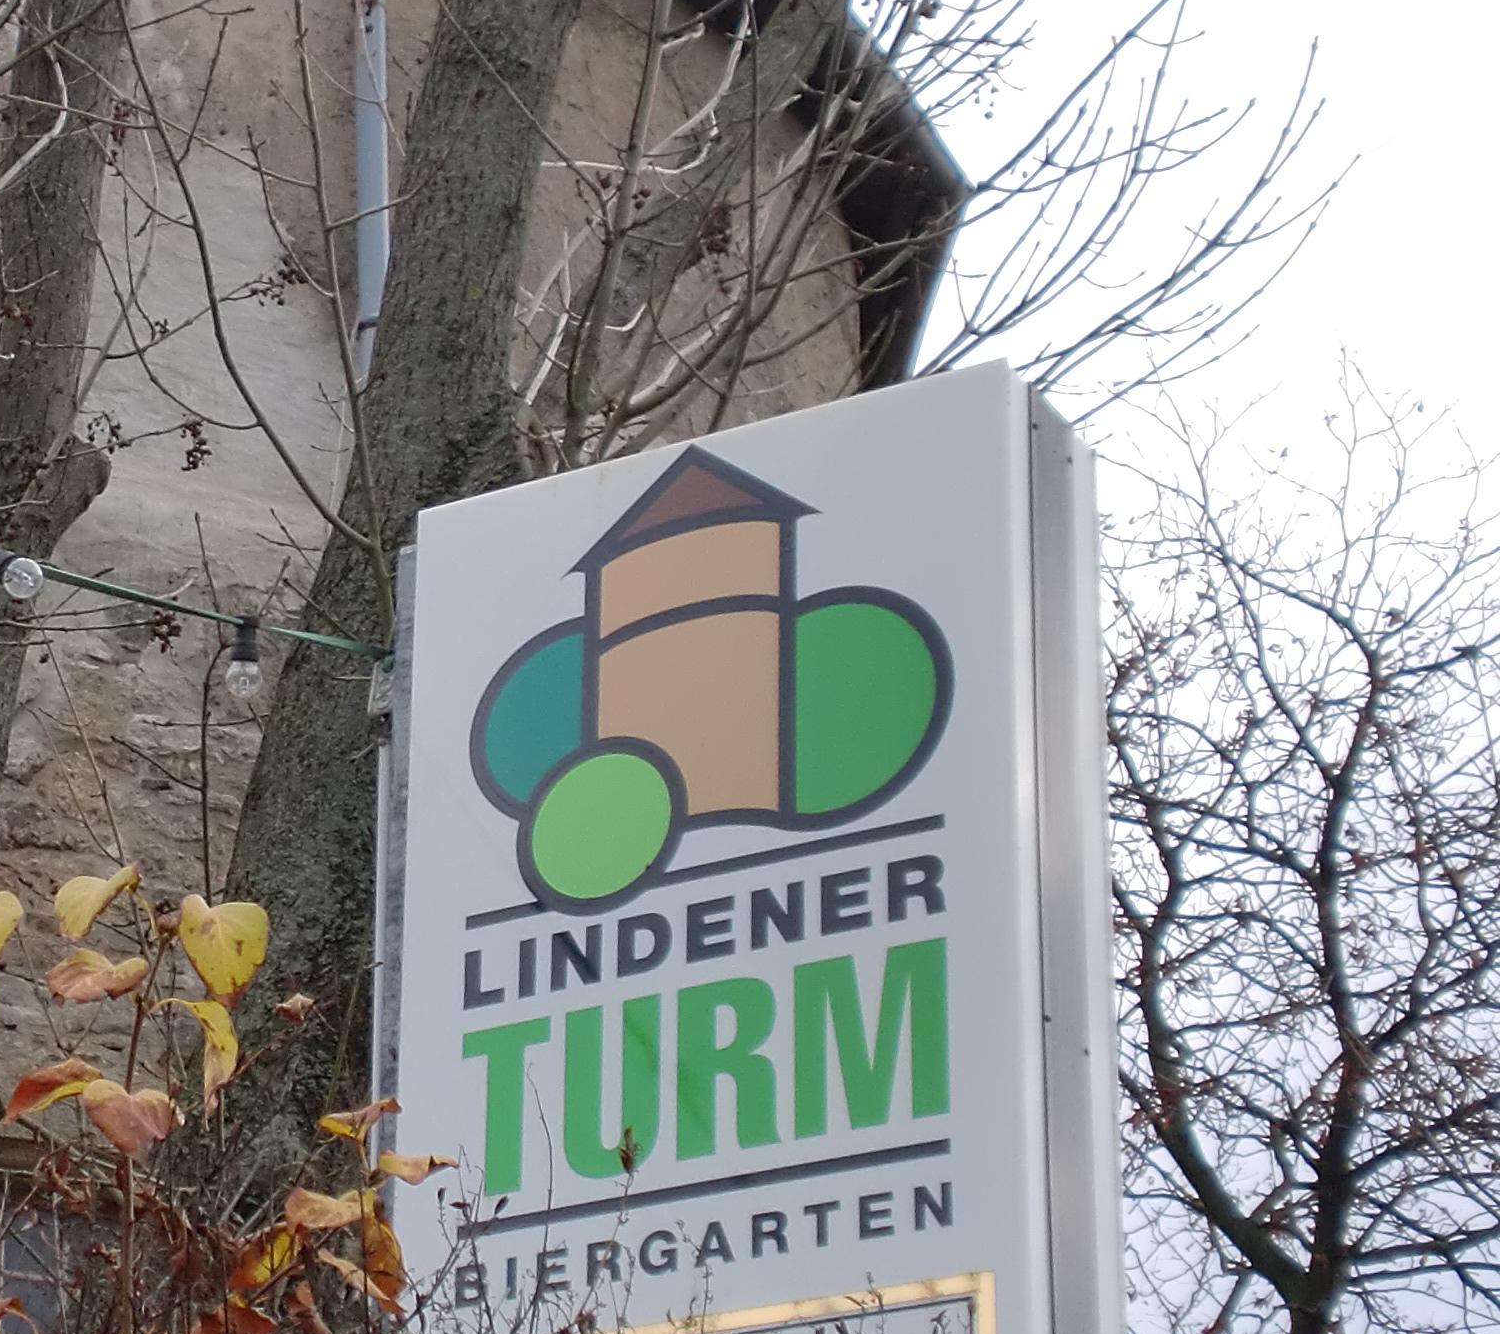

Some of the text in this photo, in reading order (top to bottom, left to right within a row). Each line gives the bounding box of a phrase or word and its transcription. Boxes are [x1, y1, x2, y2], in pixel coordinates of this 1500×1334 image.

[463, 854, 946, 1010] LINDENER
[462, 936, 950, 1198] TURM
[454, 1181, 954, 1309] BIERGARTEN
